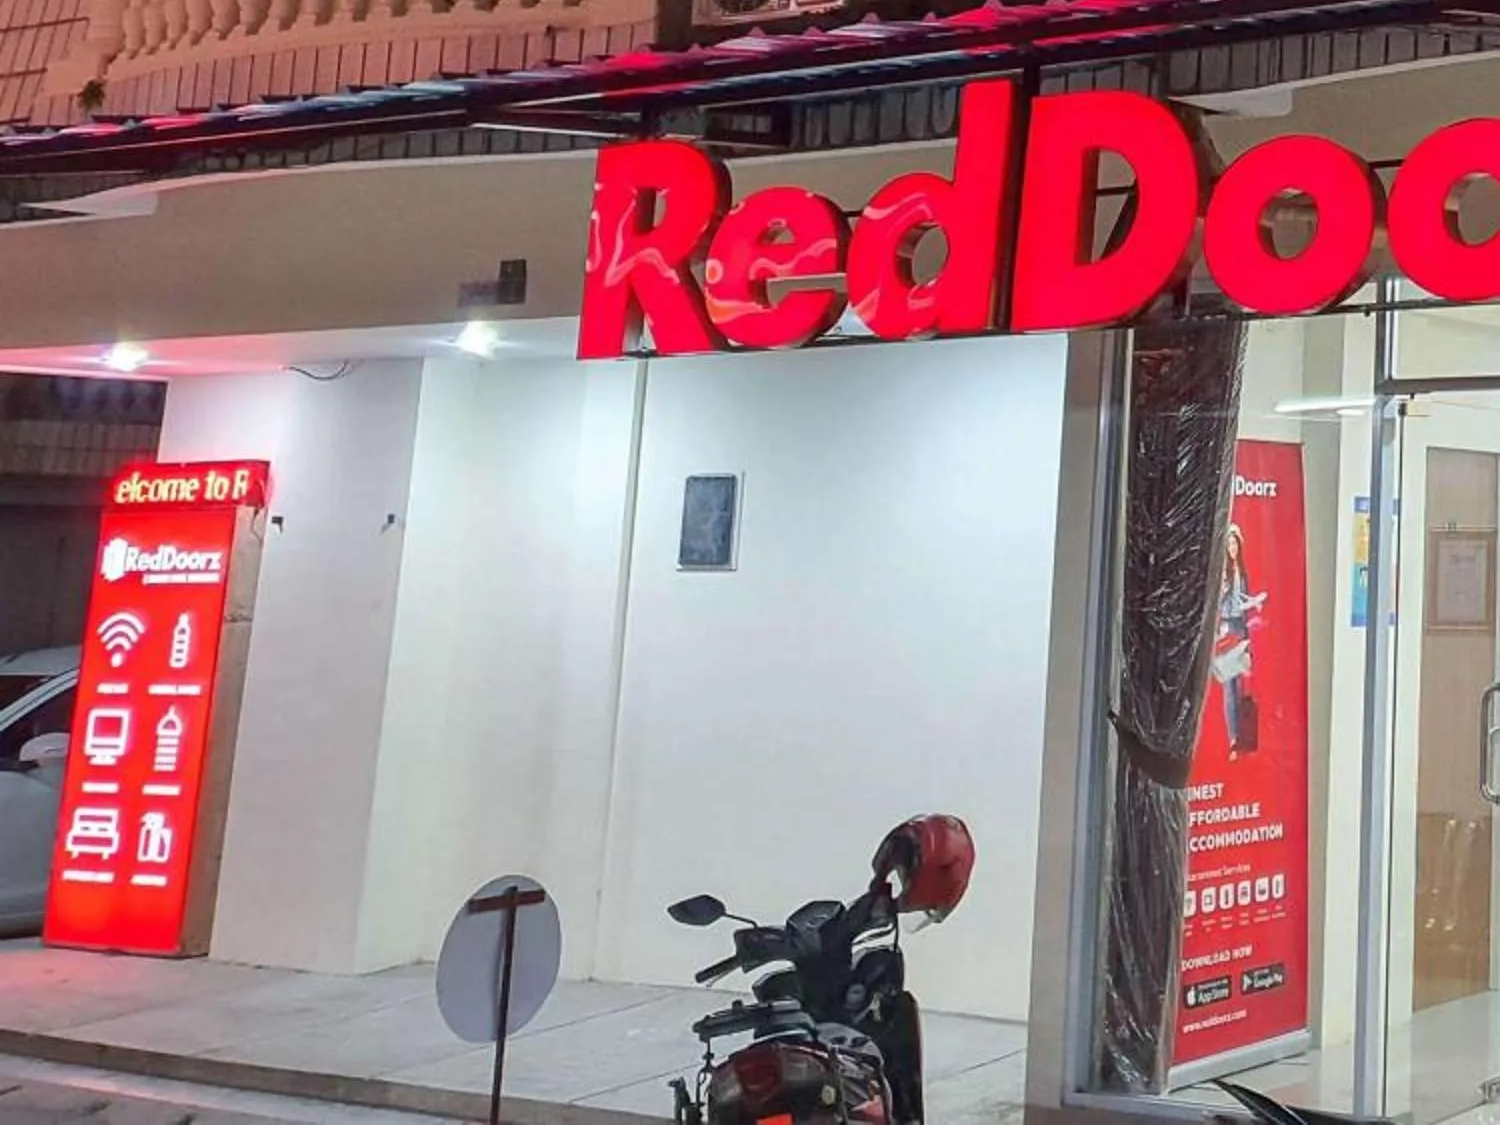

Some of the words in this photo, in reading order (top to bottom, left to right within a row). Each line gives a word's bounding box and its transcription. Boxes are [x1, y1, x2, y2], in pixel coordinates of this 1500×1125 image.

[204, 470, 230, 501] to
[1231, 475, 1277, 497] Doorz
[125, 544, 223, 572] RedDoorz
[1187, 783, 1224, 802] INEST
[1188, 802, 1260, 828] FFORDABLE
[1188, 822, 1283, 852] CCOMMODATION
